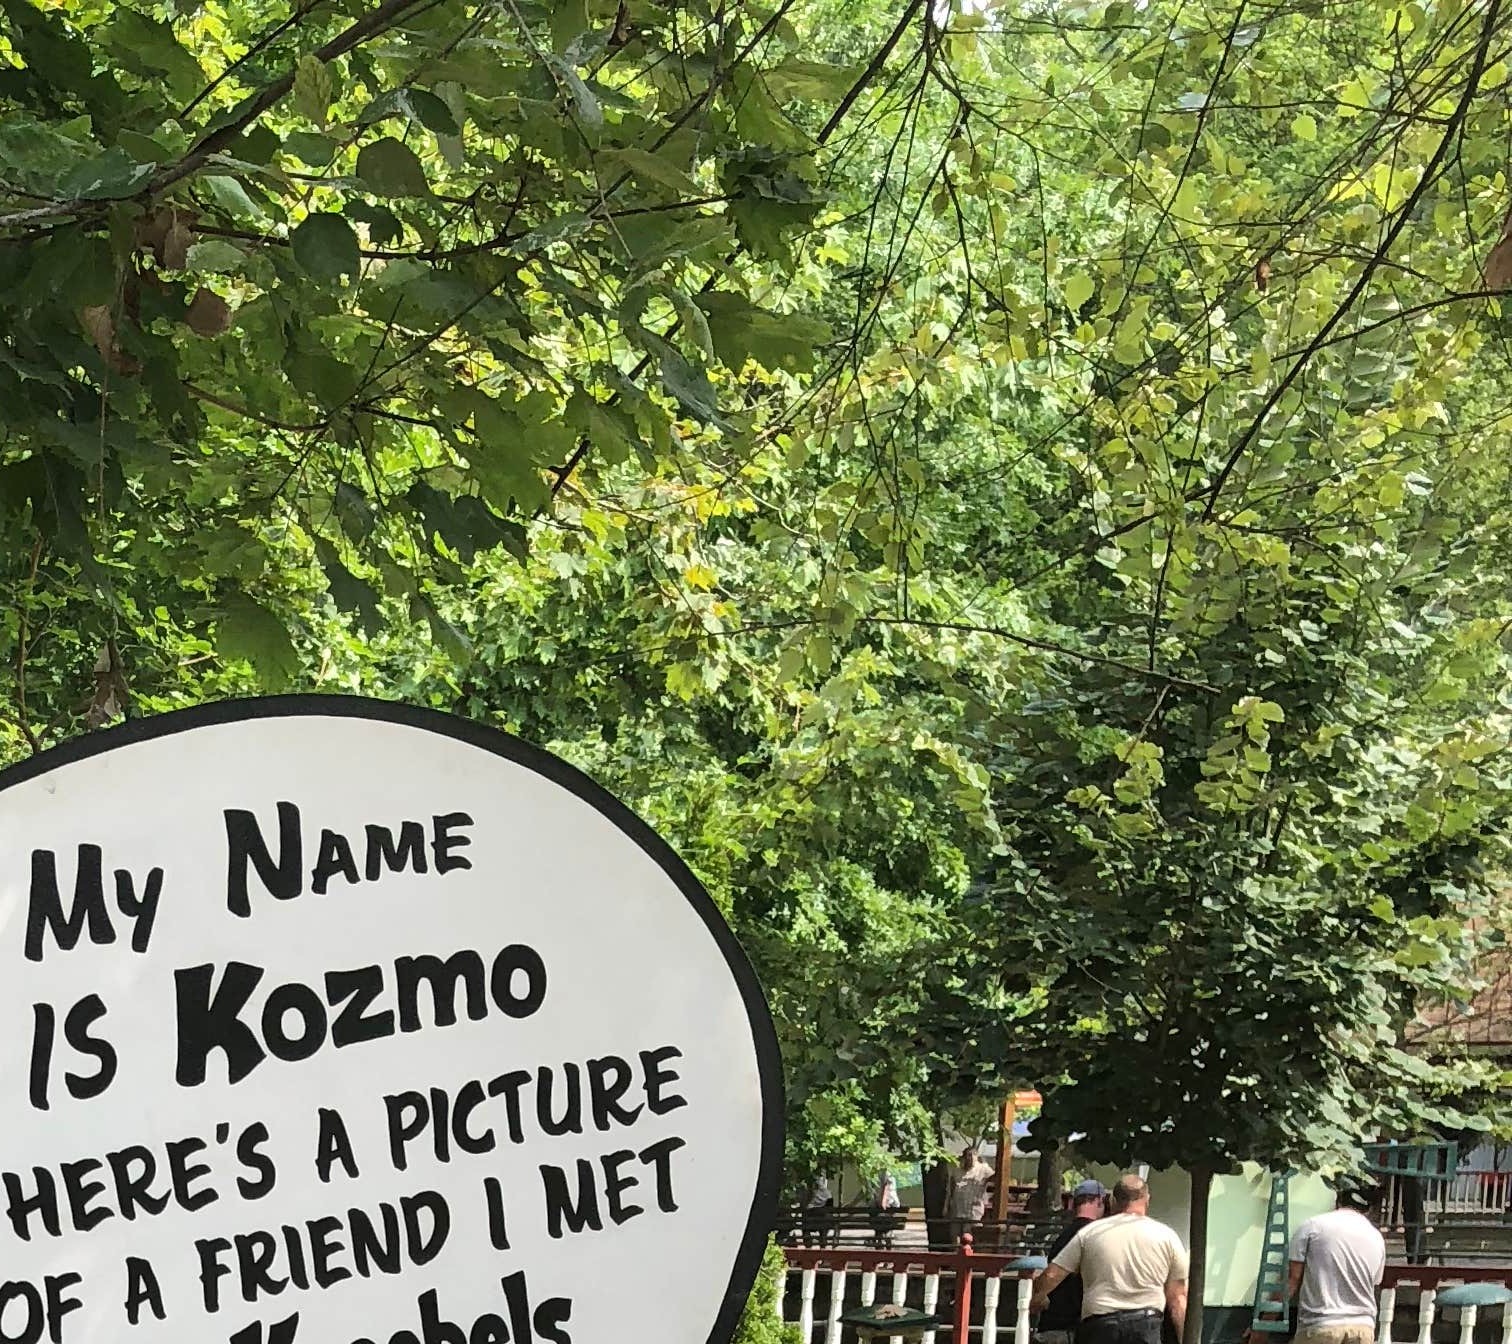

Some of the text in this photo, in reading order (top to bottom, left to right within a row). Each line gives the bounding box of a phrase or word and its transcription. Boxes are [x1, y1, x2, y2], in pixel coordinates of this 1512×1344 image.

[224, 802, 474, 917] NAME
[30, 945, 546, 1110] IS Kozmo
[2, 1046, 687, 1241] HERE'S A PICTURE
[125, 1257, 166, 1324] A
[195, 1191, 450, 1312] FRIEND
[484, 1178, 510, 1250] I
[539, 1137, 685, 1238] MET
